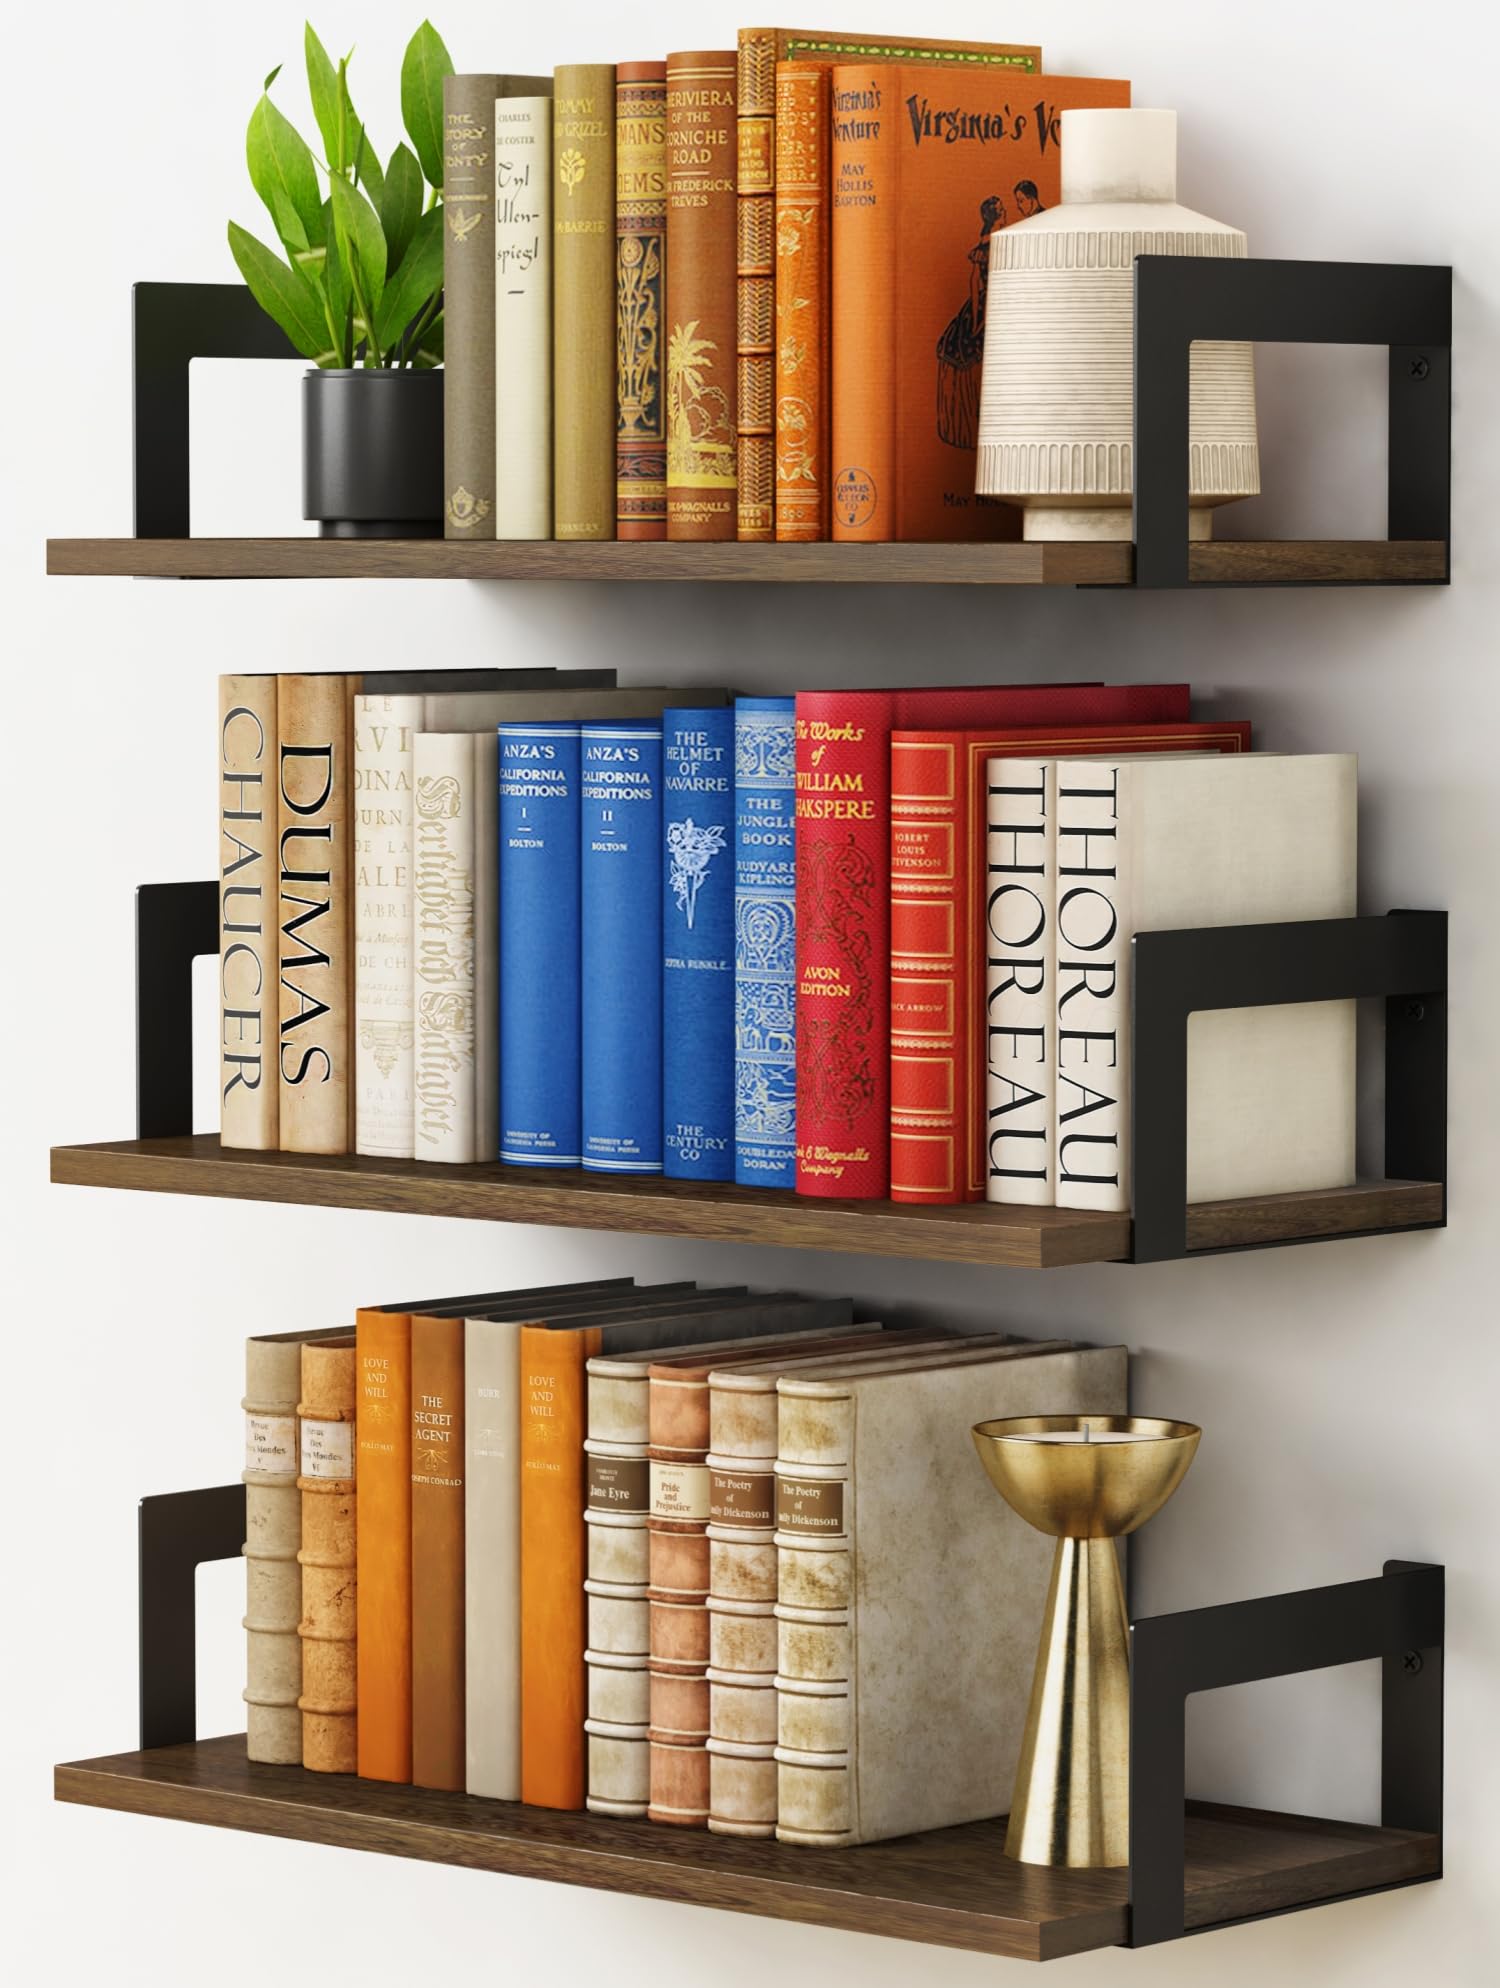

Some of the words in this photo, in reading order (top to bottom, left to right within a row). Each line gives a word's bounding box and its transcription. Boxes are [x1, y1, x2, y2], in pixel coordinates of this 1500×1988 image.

[499, 113, 532, 122] CHARLES
[671, 112, 682, 124] OF
[686, 111, 711, 123] THE
[905, 93, 1027, 148] Virginia's
[505, 136, 536, 145] COSTER
[446, 152, 488, 168] ONTY
[672, 148, 712, 165] ROAD
[617, 171, 665, 193] OEMS
[674, 730, 709, 747] THE
[810, 721, 865, 742] Works
[504, 744, 556, 759] ANZA'S
[586, 747, 641, 762] ANZA'S
[666, 745, 725, 762] HELMET
[811, 745, 827, 768] of
[500, 768, 567, 781] CALIFORNIA
[678, 761, 701, 776] OF
[582, 770, 651, 784] CALIFORNIA
[796, 772, 864, 792] WILLIAM
[500, 783, 569, 797] EXPEDITIONS
[582, 785, 654, 800] EXPEDITIONS
[745, 797, 783, 811] THE
[602, 809, 614, 822] II
[737, 815, 796, 829] JUNGLE
[508, 838, 545, 848] BOLTON
[741, 831, 793, 846] BOOK
[591, 841, 628, 852] BOLTON
[222, 706, 264, 1110] CHAUCER
[280, 741, 333, 1085] DUMAS
[803, 966, 841, 980] AVON
[987, 765, 1048, 1183] THOREAU
[1058, 767, 1119, 1189] THOREAU
[800, 983, 851, 997] EDITION
[676, 1124, 705, 1137] THE
[665, 1134, 728, 1150] CENTURY
[679, 1148, 701, 1161] CO
[743, 1158, 787, 1171] DORAN
[362, 1357, 389, 1369] LOVE
[366, 1372, 388, 1384] AND
[528, 1375, 556, 1388] LOVE
[364, 1385, 388, 1398] WILL
[531, 1390, 555, 1403] AND
[421, 1395, 444, 1409] THE
[529, 1404, 556, 1417] WILL
[414, 1410, 453, 1427] SECRET
[415, 1428, 452, 1443] AGENT
[411, 1473, 430, 1484] OSEPH
[430, 1476, 462, 1488] CONRAD
[661, 1481, 681, 1493] Pride
[714, 1477, 727, 1489] The
[727, 1479, 753, 1493] Poetry
[589, 1483, 608, 1498] Jane
[608, 1486, 631, 1502] Eyre
[663, 1491, 678, 1502] and
[725, 1493, 735, 1503] of
[783, 1483, 795, 1496] The
[795, 1486, 822, 1500] Poetry
[794, 1500, 803, 1511] of
